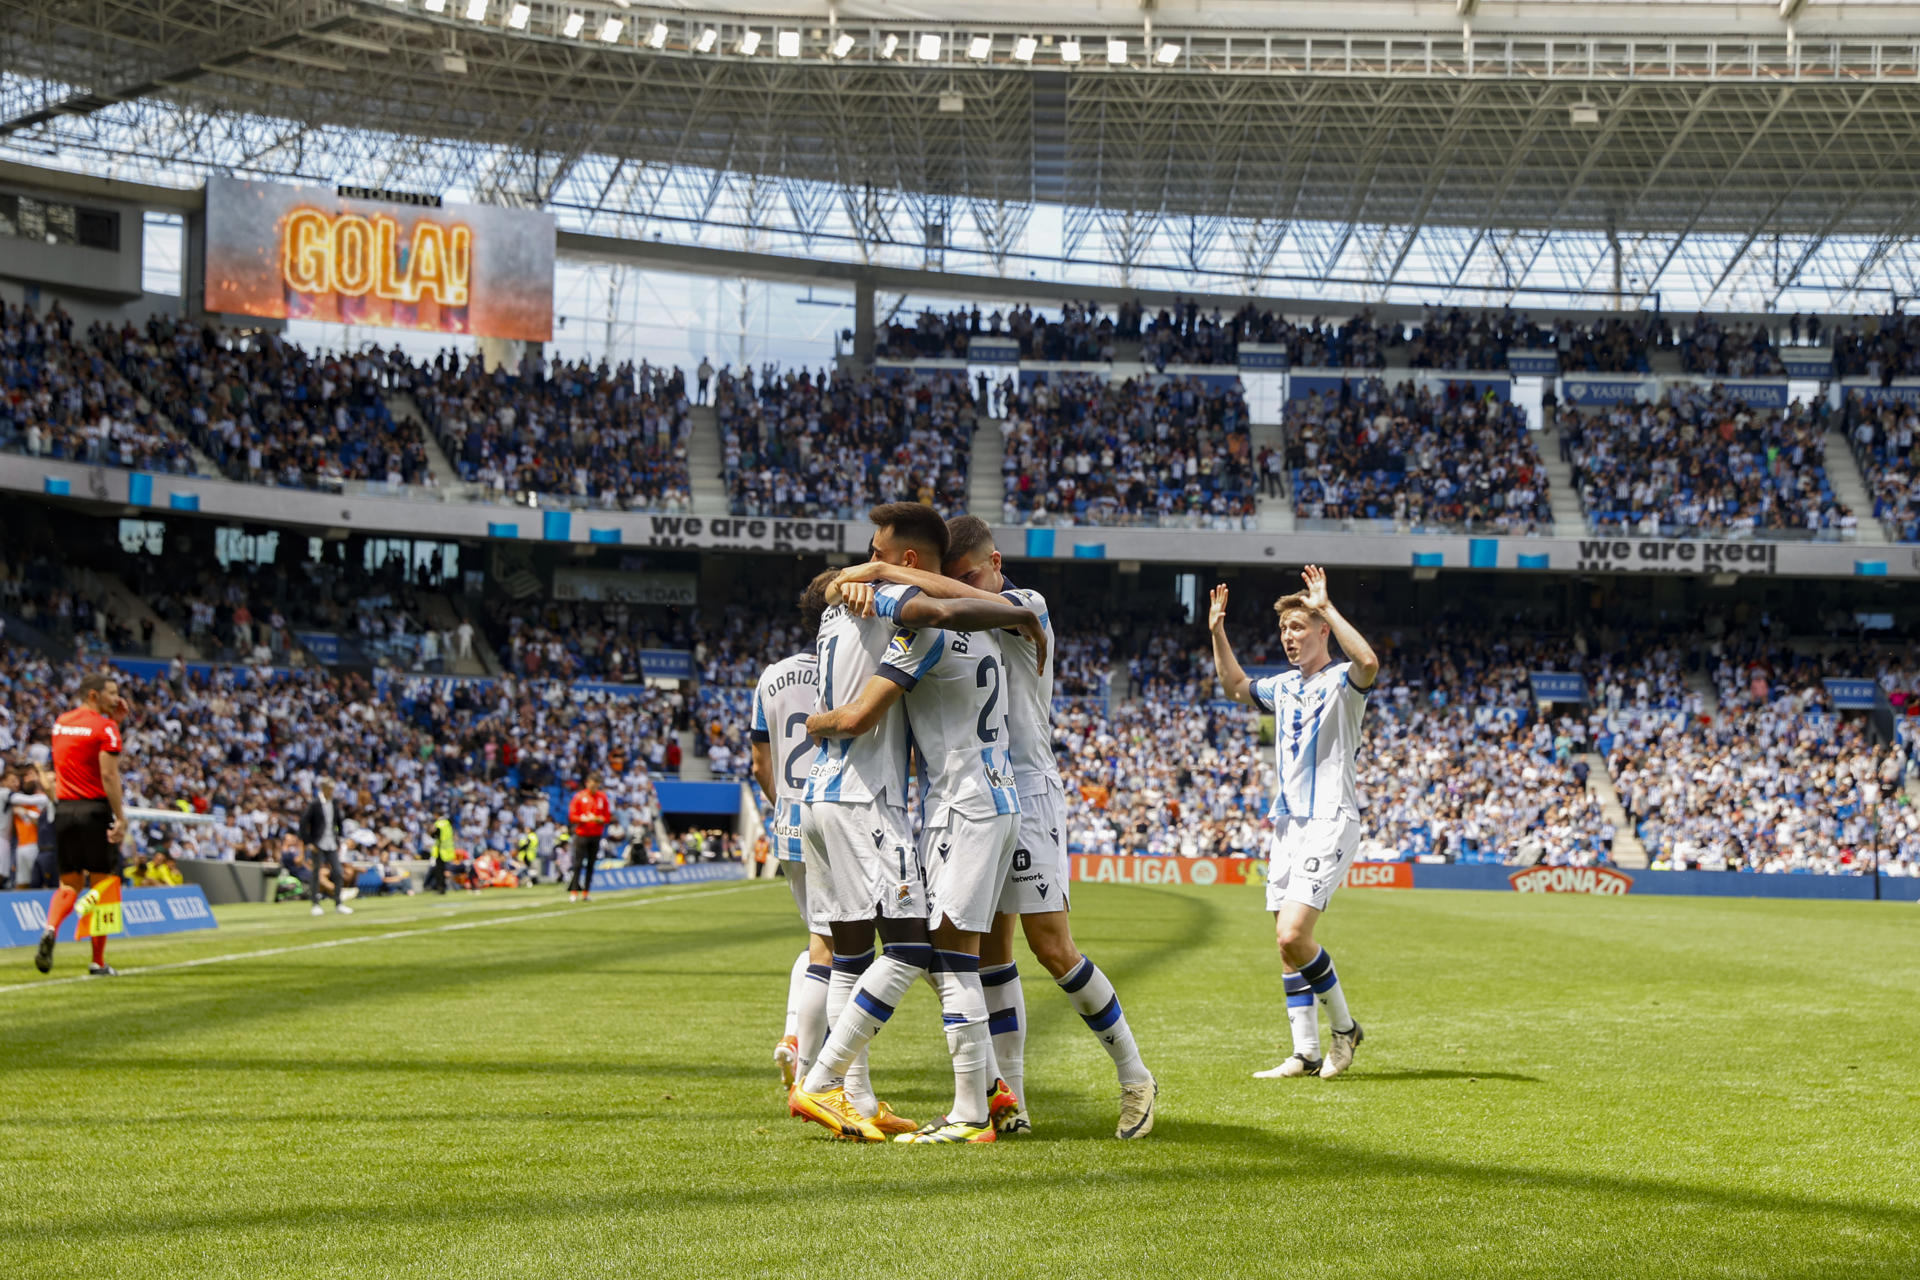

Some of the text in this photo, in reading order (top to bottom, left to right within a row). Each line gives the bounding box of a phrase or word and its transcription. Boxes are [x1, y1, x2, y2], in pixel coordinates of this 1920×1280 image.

[285, 208, 470, 306] GOLA!
[651, 516, 702, 536] We
[710, 518, 766, 538] are
[1579, 541, 1630, 560] We
[1638, 542, 1696, 562] are
[976, 654, 1008, 743] 2
[1079, 857, 1182, 885] LALIGA
